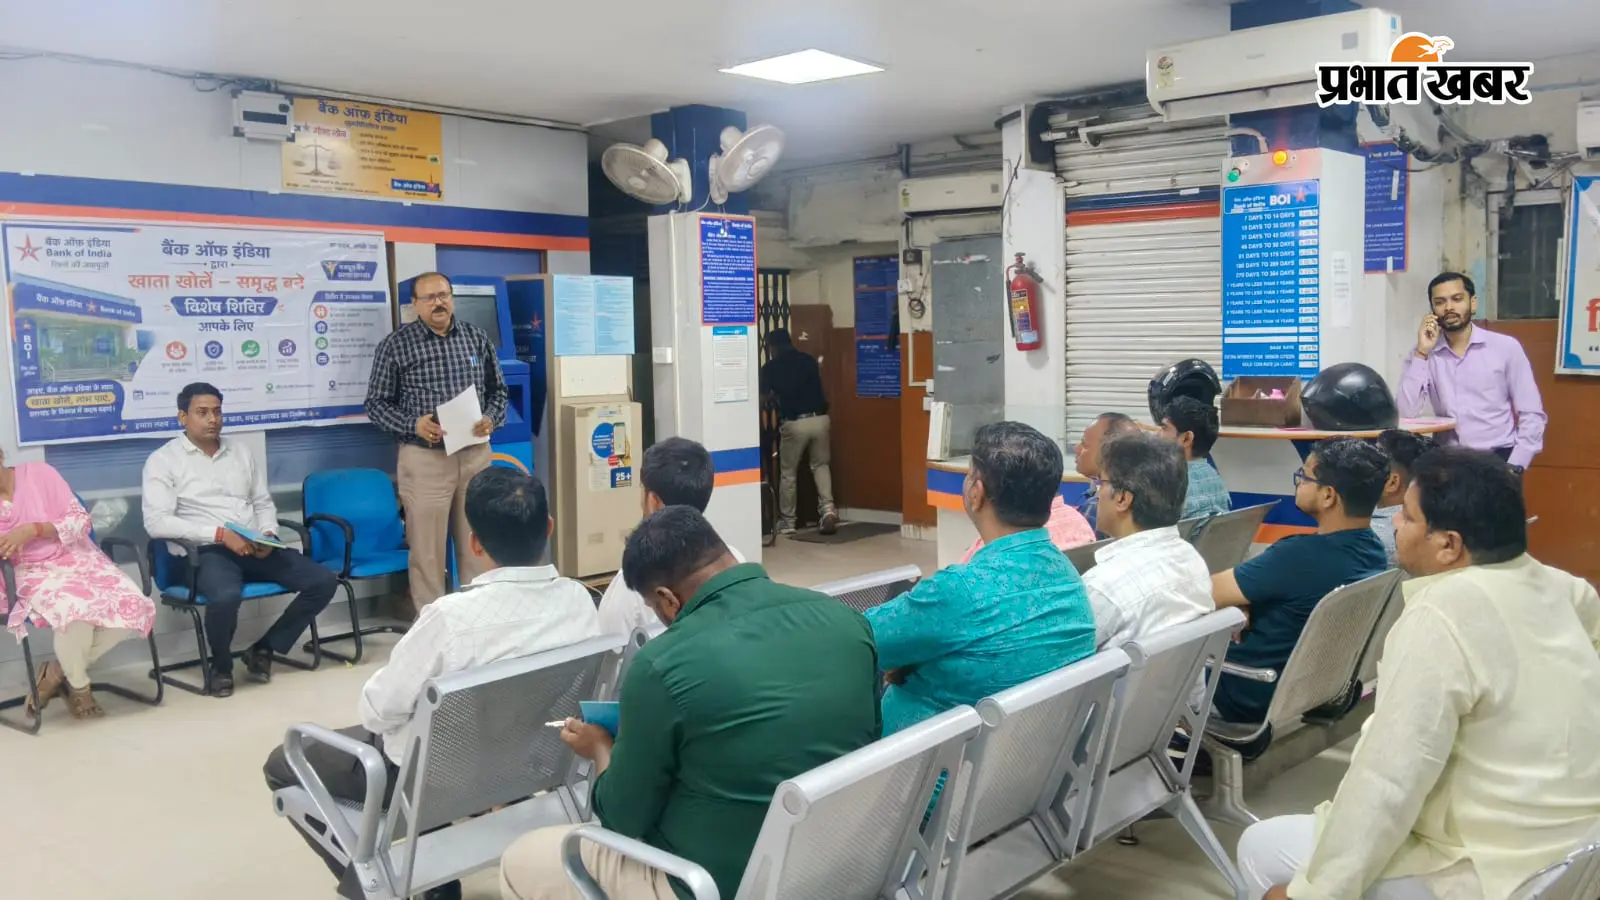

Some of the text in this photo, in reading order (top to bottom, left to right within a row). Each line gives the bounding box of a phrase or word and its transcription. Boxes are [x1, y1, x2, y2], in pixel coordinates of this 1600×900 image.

[318, 100, 339, 114] बैंक
[374, 110, 408, 124] इंडिया
[1270, 194, 1291, 206] BOI
[45, 237, 61, 246] बैंक
[88, 238, 111, 248] इंडिया
[161, 239, 271, 260] बैंक ऑफ इंडिया
[46, 249, 112, 258] Bank of India
[128, 274, 170, 289] खाता
[175, 271, 213, 289] खोलें
[237, 276, 277, 293] समृद्ध
[184, 298, 264, 314] विशेष शिविर
[198, 319, 254, 332] आपके लिए
[24, 335, 32, 359] BOI
[616, 472, 631, 481] 25+
